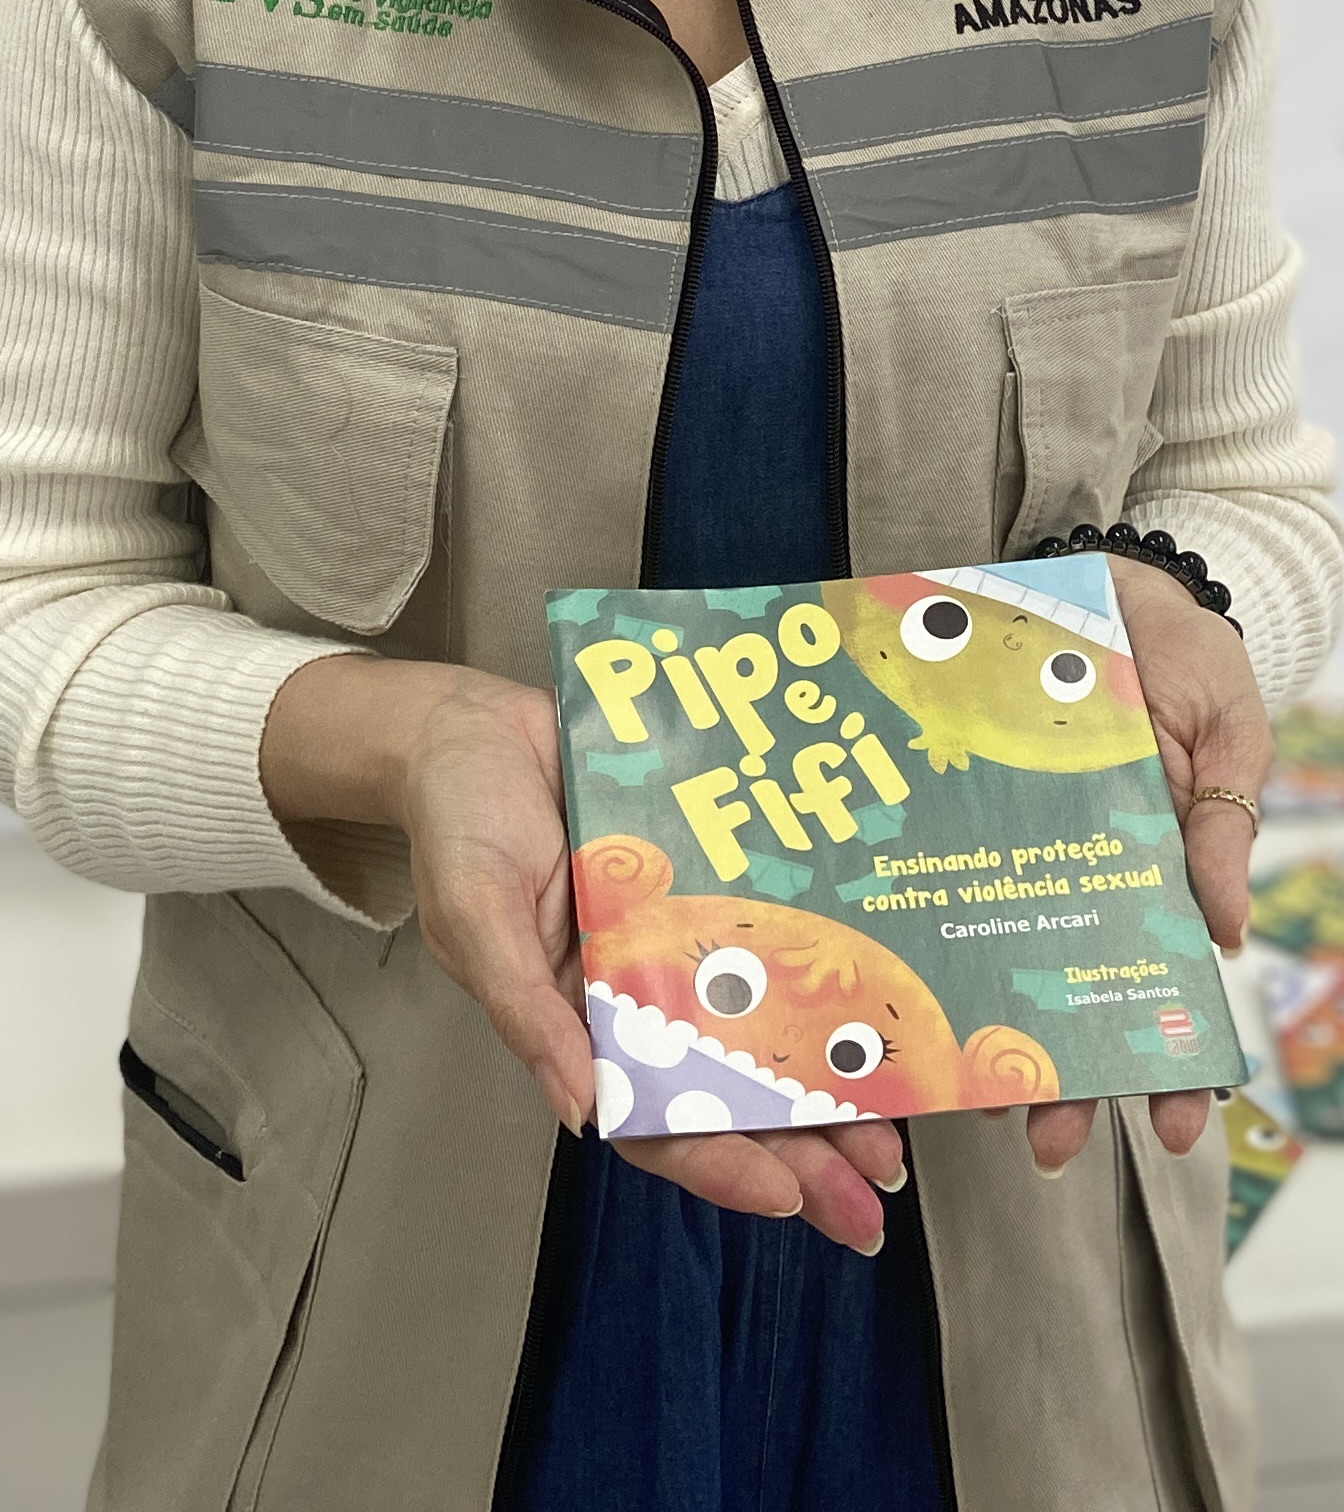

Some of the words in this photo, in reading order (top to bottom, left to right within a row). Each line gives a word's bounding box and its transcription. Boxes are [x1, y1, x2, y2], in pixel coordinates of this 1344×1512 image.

[326, 2, 366, 28] em
[373, 10, 454, 38] Saúde
[574, 603, 841, 756] Pipo
[784, 679, 837, 724] e
[671, 711, 911, 882] Fifi
[873, 846, 1002, 878] Ensinando
[1011, 833, 1124, 875] proteção
[862, 886, 949, 913] contra
[957, 874, 1071, 905] violência
[1079, 864, 1164, 894] sexual
[940, 918, 1031, 939] Caroline
[1036, 909, 1100, 930] Arcari
[1064, 958, 1169, 984] Ilustrações
[1066, 990, 1123, 1006] Isabela
[1127, 986, 1180, 1001] Santos
